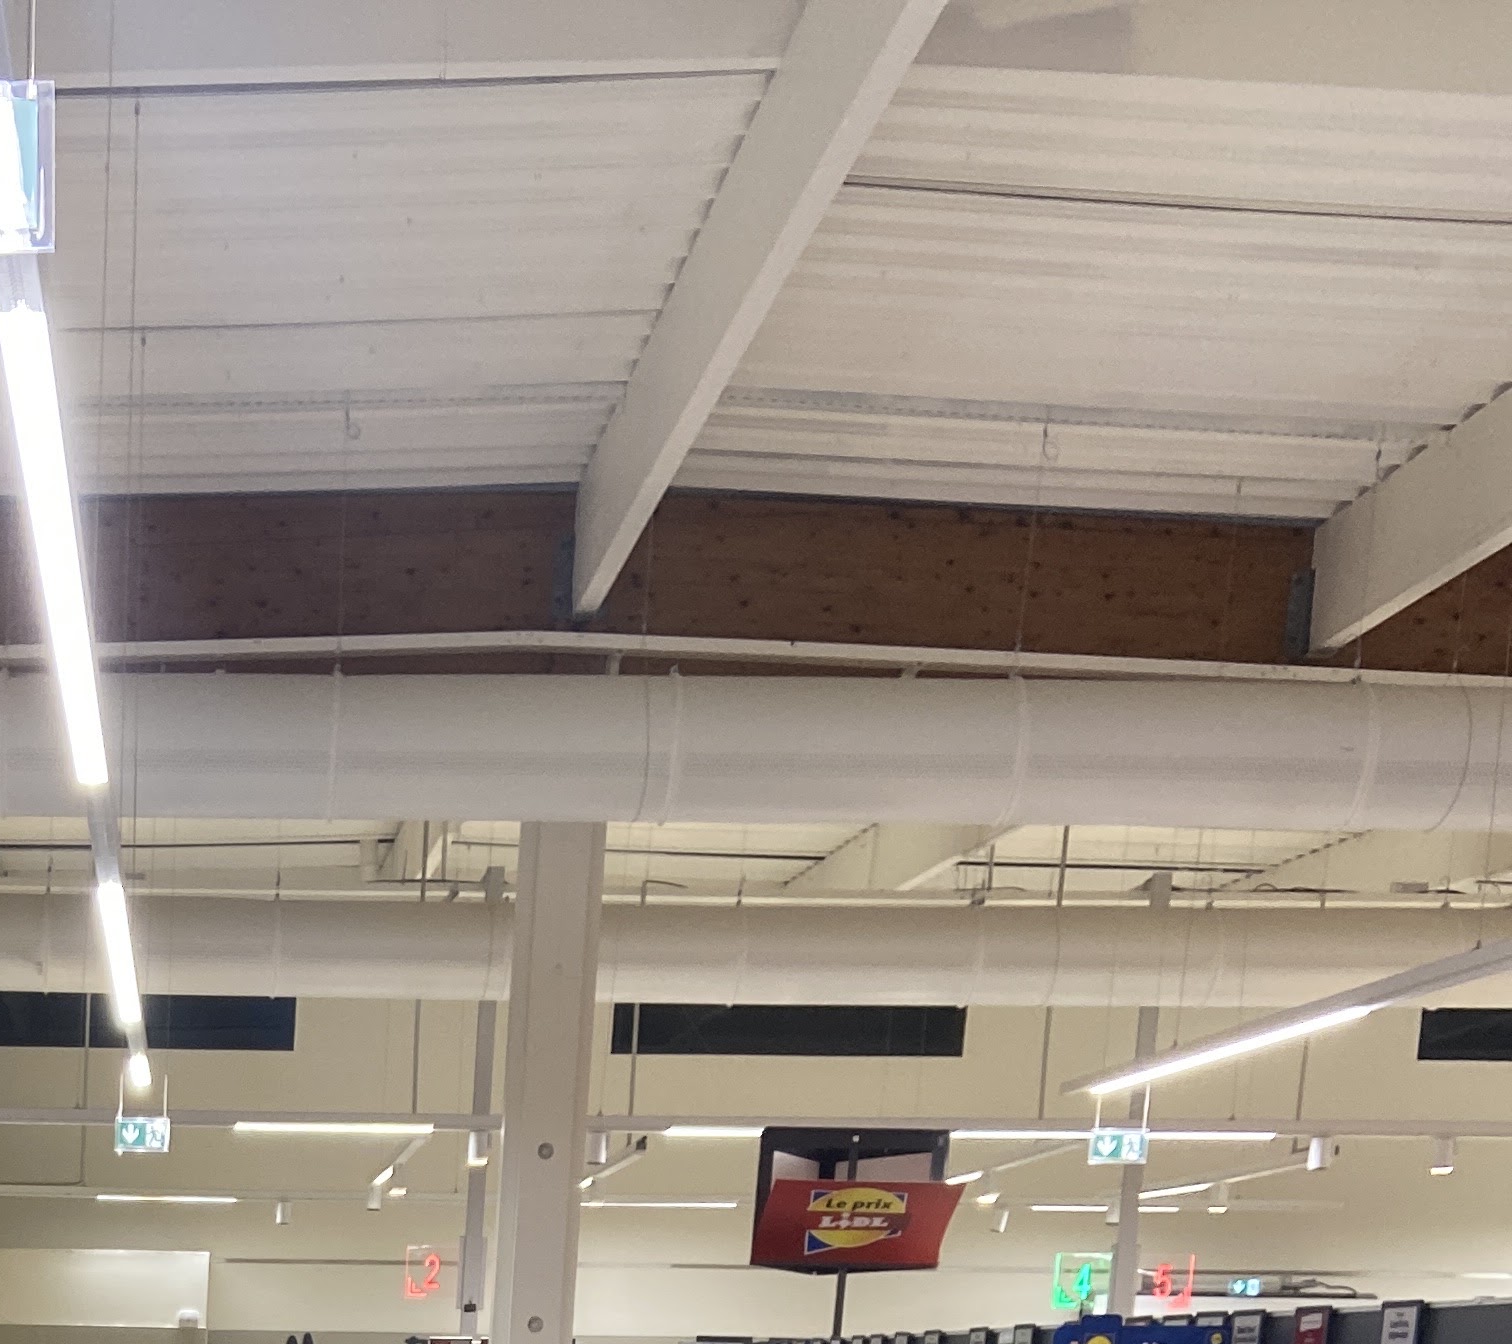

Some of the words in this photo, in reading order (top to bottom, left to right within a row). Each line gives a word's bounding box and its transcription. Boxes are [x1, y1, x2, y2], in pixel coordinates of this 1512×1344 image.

[825, 1198, 848, 1210] Le
[852, 1198, 894, 1212] prix
[424, 1253, 441, 1289] 2
[1072, 1263, 1092, 1300] 4
[1153, 1263, 1174, 1298] 5
